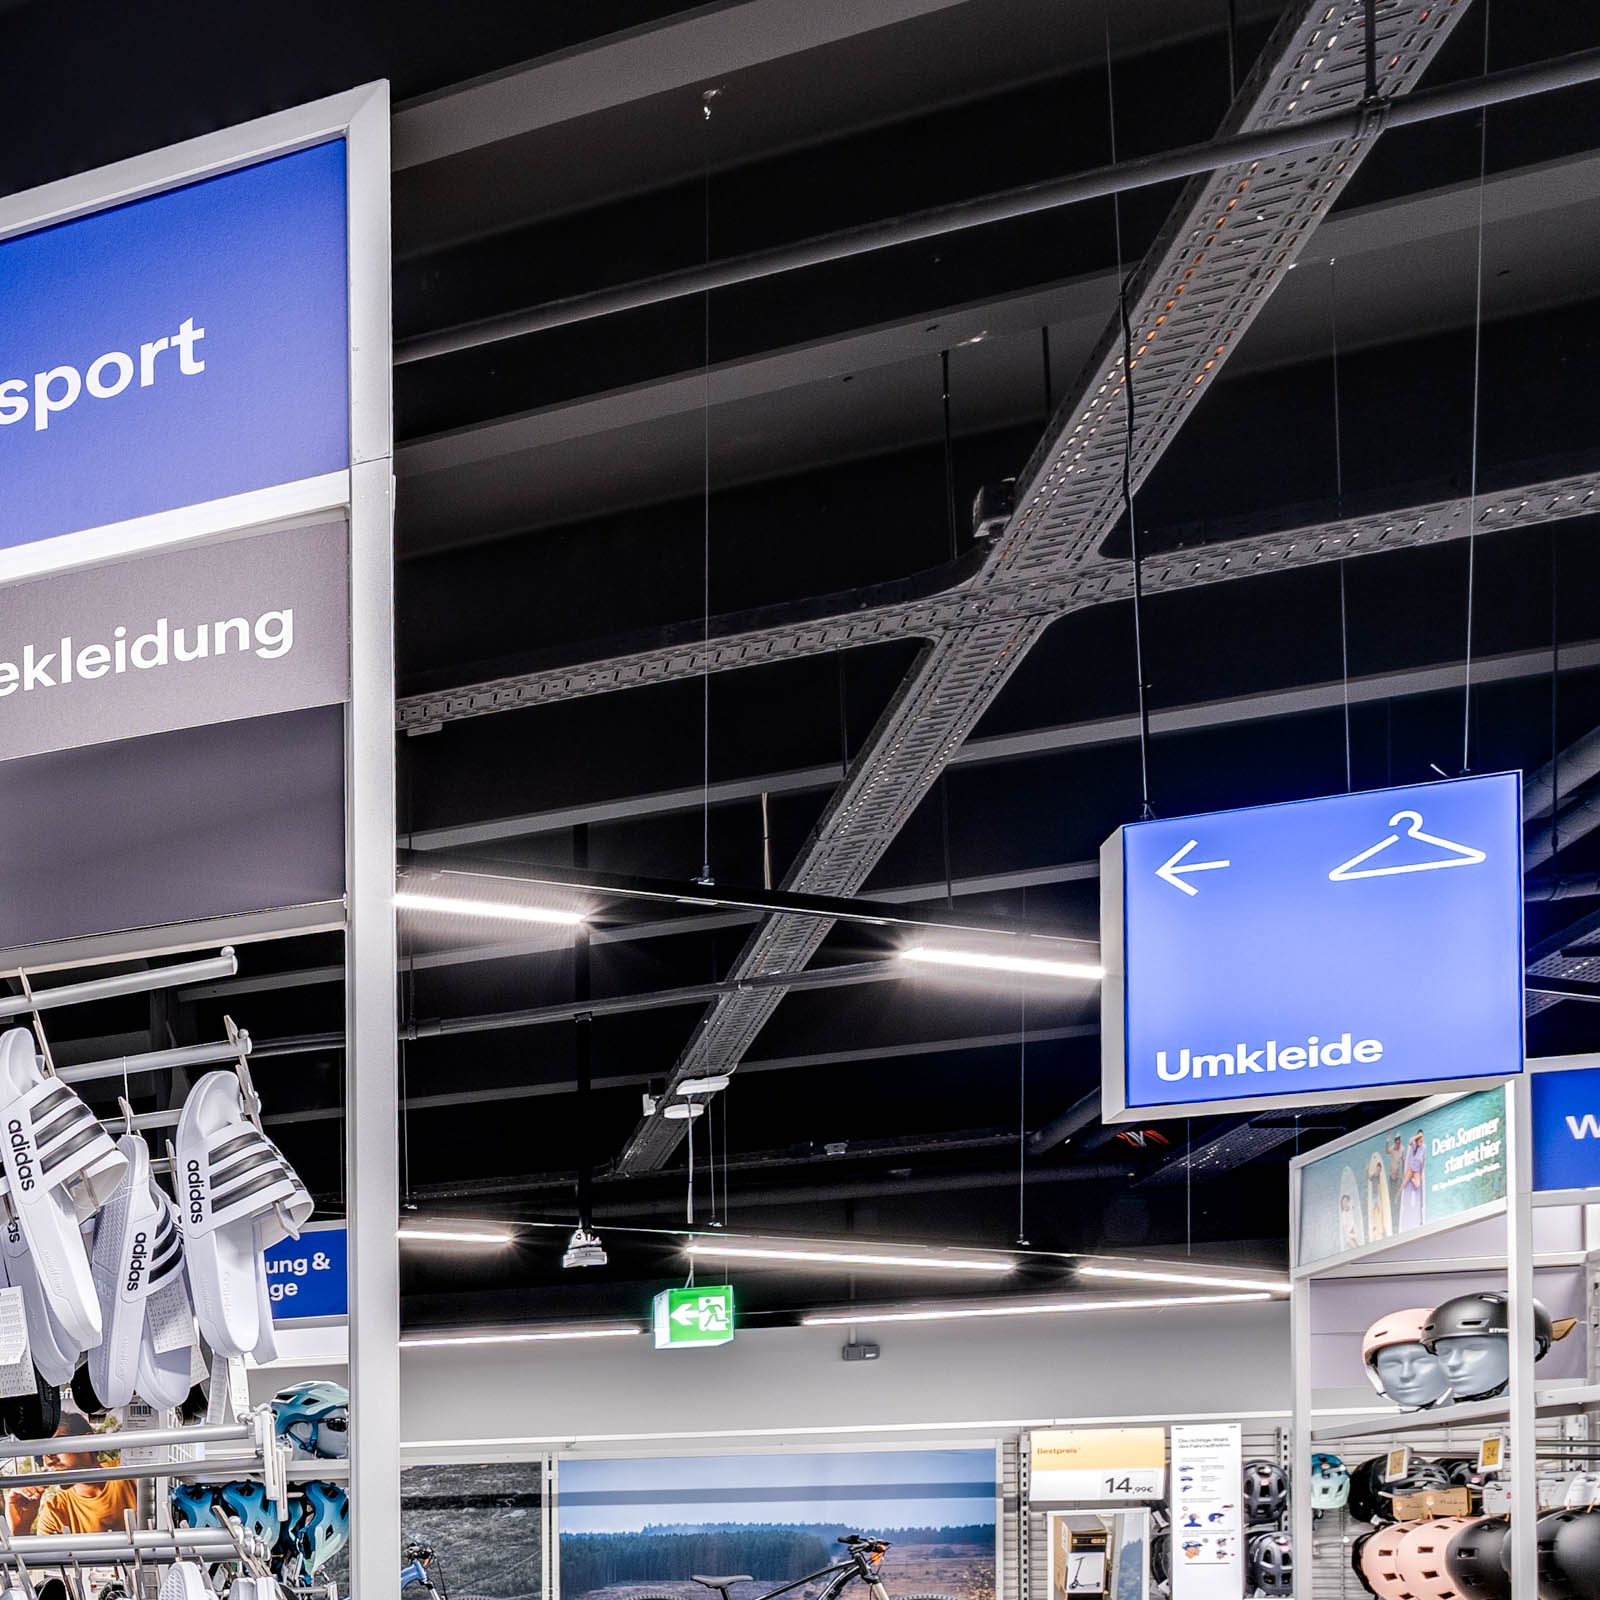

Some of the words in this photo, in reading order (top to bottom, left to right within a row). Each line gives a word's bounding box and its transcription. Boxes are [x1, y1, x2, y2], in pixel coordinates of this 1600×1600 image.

[1155, 1032, 1384, 1083] Umkleide
[8, 1119, 35, 1192] adidas
[1431, 1135, 1456, 1157] Dein
[1456, 1117, 1500, 1146] Sommer
[186, 1159, 205, 1225] adidas
[126, 1231, 148, 1292] adidas
[312, 1252, 331, 1270] &
